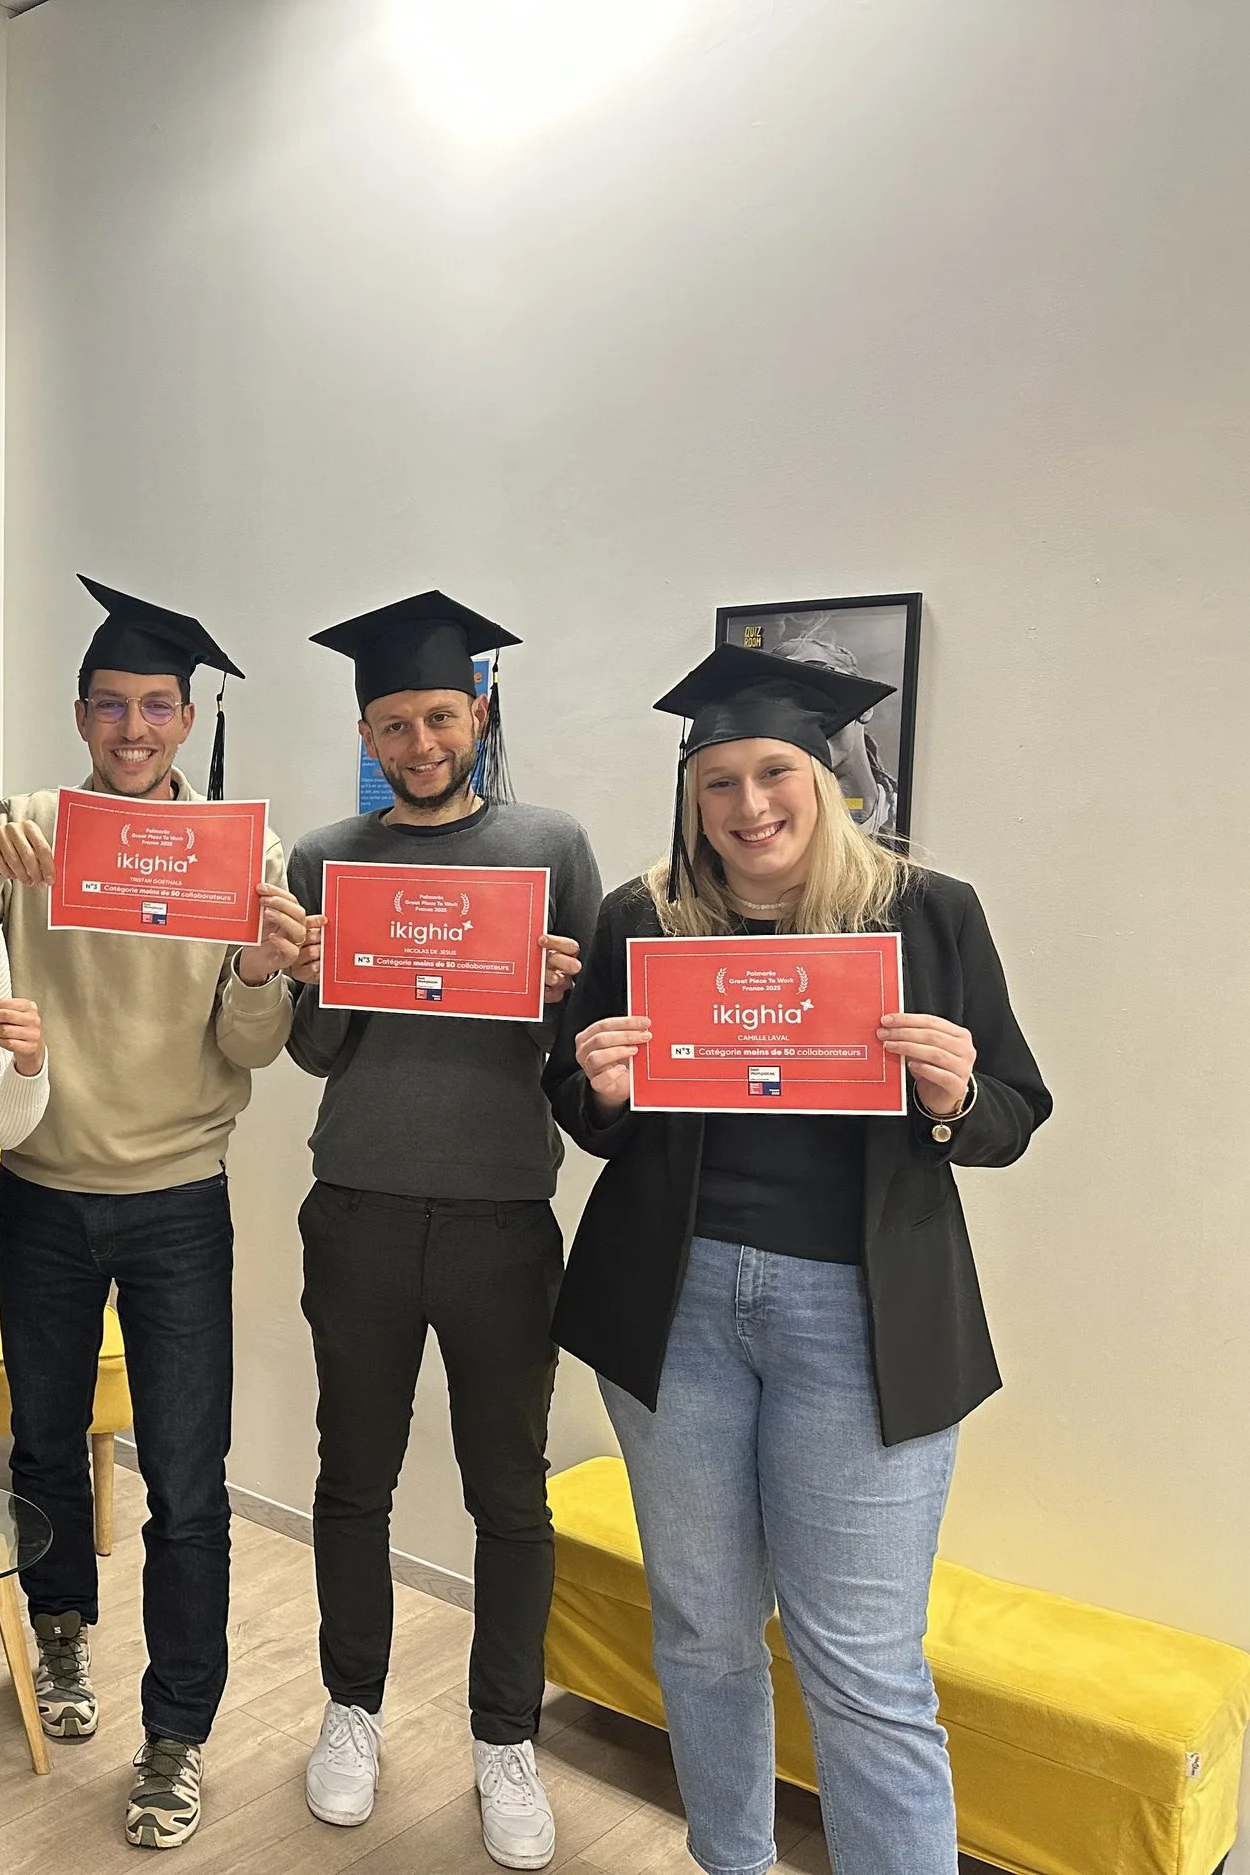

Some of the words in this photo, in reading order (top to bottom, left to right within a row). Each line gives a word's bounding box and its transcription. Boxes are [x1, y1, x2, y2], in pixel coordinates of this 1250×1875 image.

[117, 852, 188, 876] ikighia
[103, 884, 138, 894] Catégorie
[139, 888, 160, 896] moins
[180, 891, 232, 901] collaborateurs
[390, 920, 463, 945] ikighia
[358, 956, 371, 964] N°3
[376, 957, 412, 968] Catégorie
[435, 960, 445, 968] de
[445, 961, 456, 969] 50
[456, 962, 510, 971] collaborateurs
[712, 1003, 802, 1031] ikighia
[675, 1047, 691, 1056] N°3
[698, 1046, 743, 1057] Catégorie
[743, 1047, 770, 1056] moins
[770, 1047, 783, 1056] de
[783, 1048, 796, 1056] 50
[796, 1047, 862, 1057] collaborateurs
